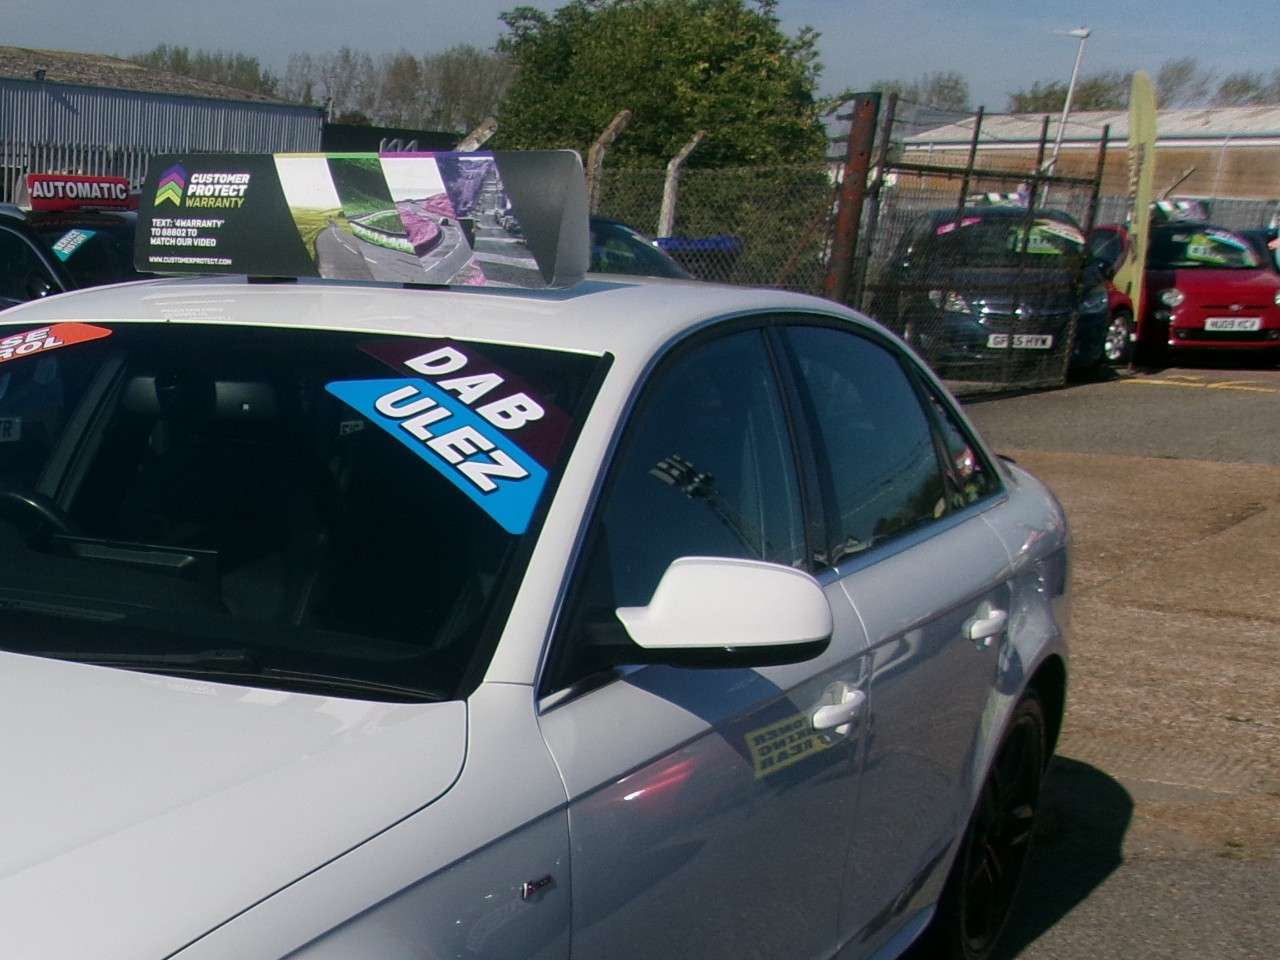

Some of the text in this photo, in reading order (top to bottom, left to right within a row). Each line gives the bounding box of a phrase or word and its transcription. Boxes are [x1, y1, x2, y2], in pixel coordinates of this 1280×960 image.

[190, 173, 250, 184] CUSTOMER
[32, 181, 127, 200] AUTOMATIC
[187, 185, 248, 196] PROTECT
[185, 197, 245, 208] WARRANTY
[152, 218, 173, 227] TEXT:
[151, 228, 161, 236] TO
[187, 228, 198, 237] TO
[176, 238, 193, 246] OUR
[193, 238, 217, 248] VIDEO
[403, 346, 546, 431] DAB
[375, 385, 530, 493] ULEZ
